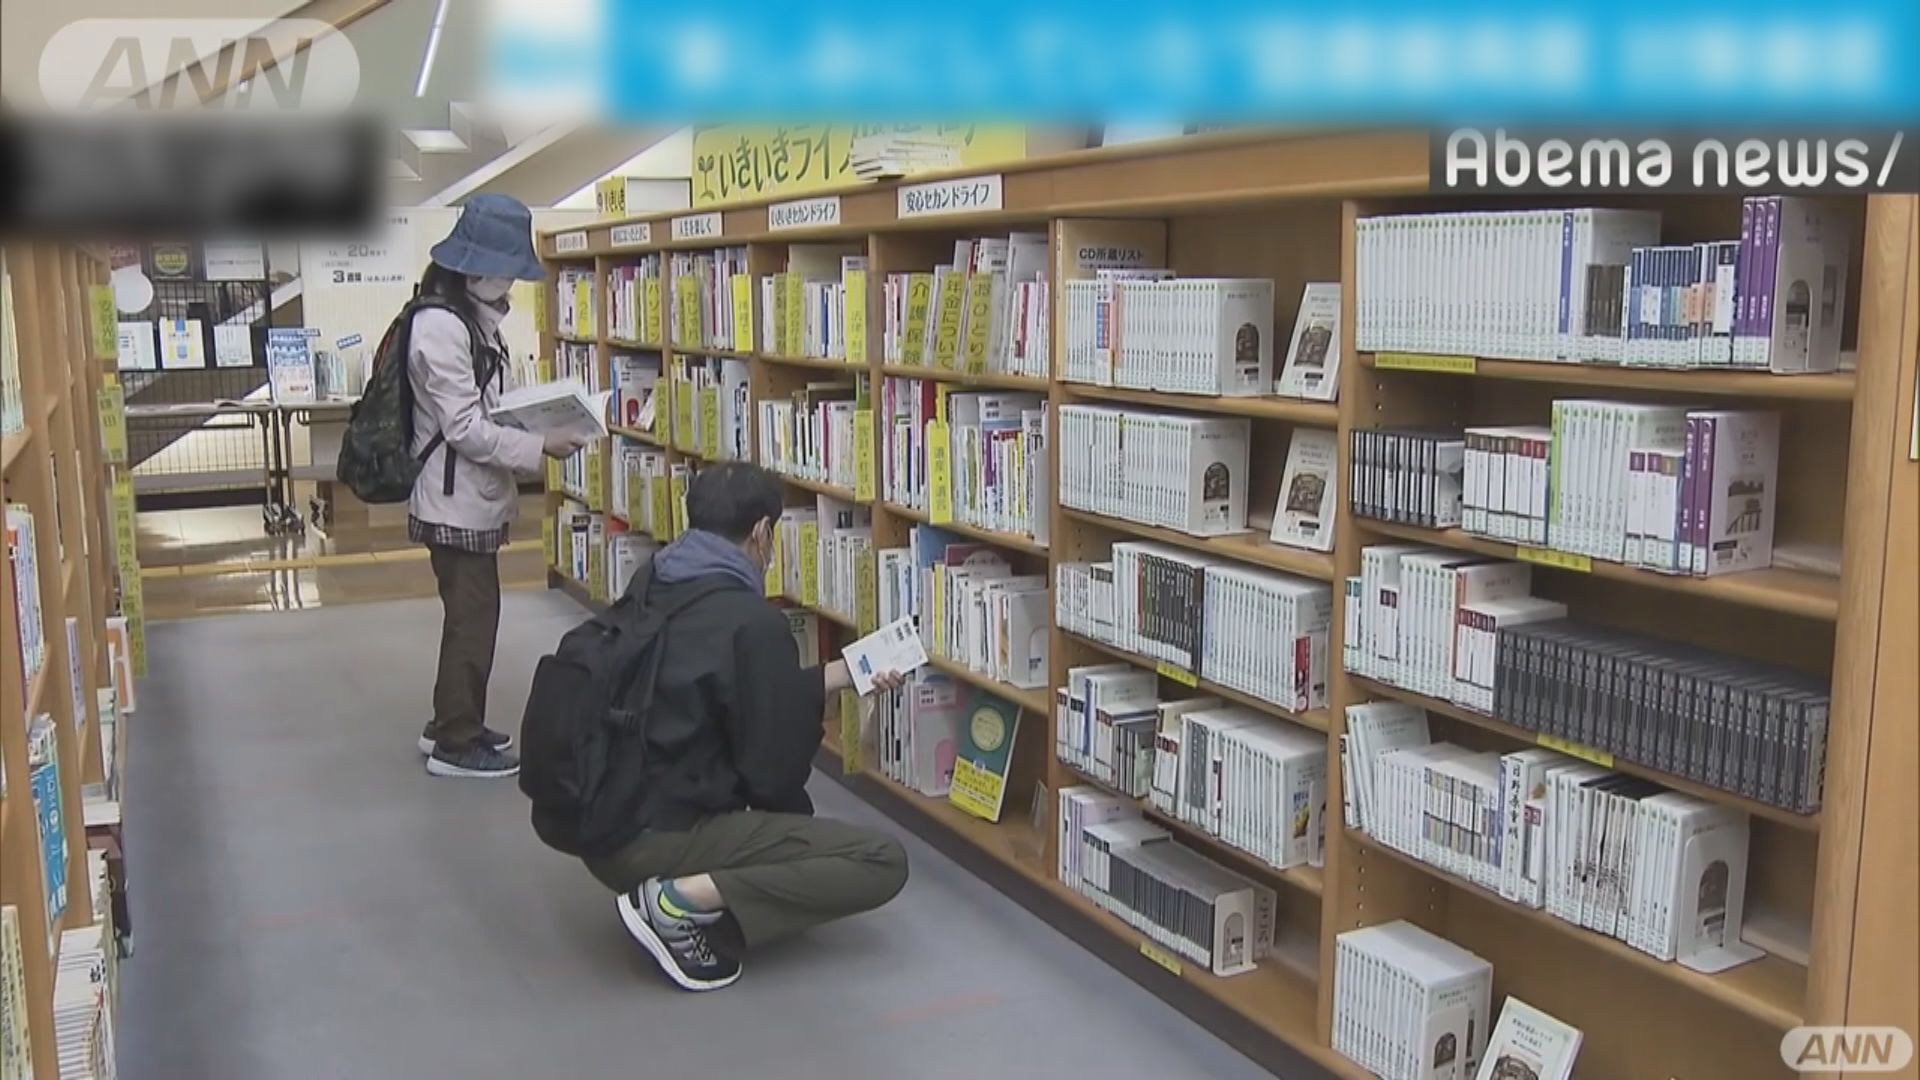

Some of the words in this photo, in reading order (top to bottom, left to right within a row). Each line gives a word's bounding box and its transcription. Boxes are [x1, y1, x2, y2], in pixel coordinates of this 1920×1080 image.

[771, 203, 836, 226] いきいきセカンドライフ
[905, 183, 990, 212] 安心セカンドライフ
[1079, 248, 1145, 262] CD所蔵リスト
[903, 281, 929, 366] 介護保険
[937, 279, 962, 370] 年金について
[967, 283, 991, 375] おひとり様
